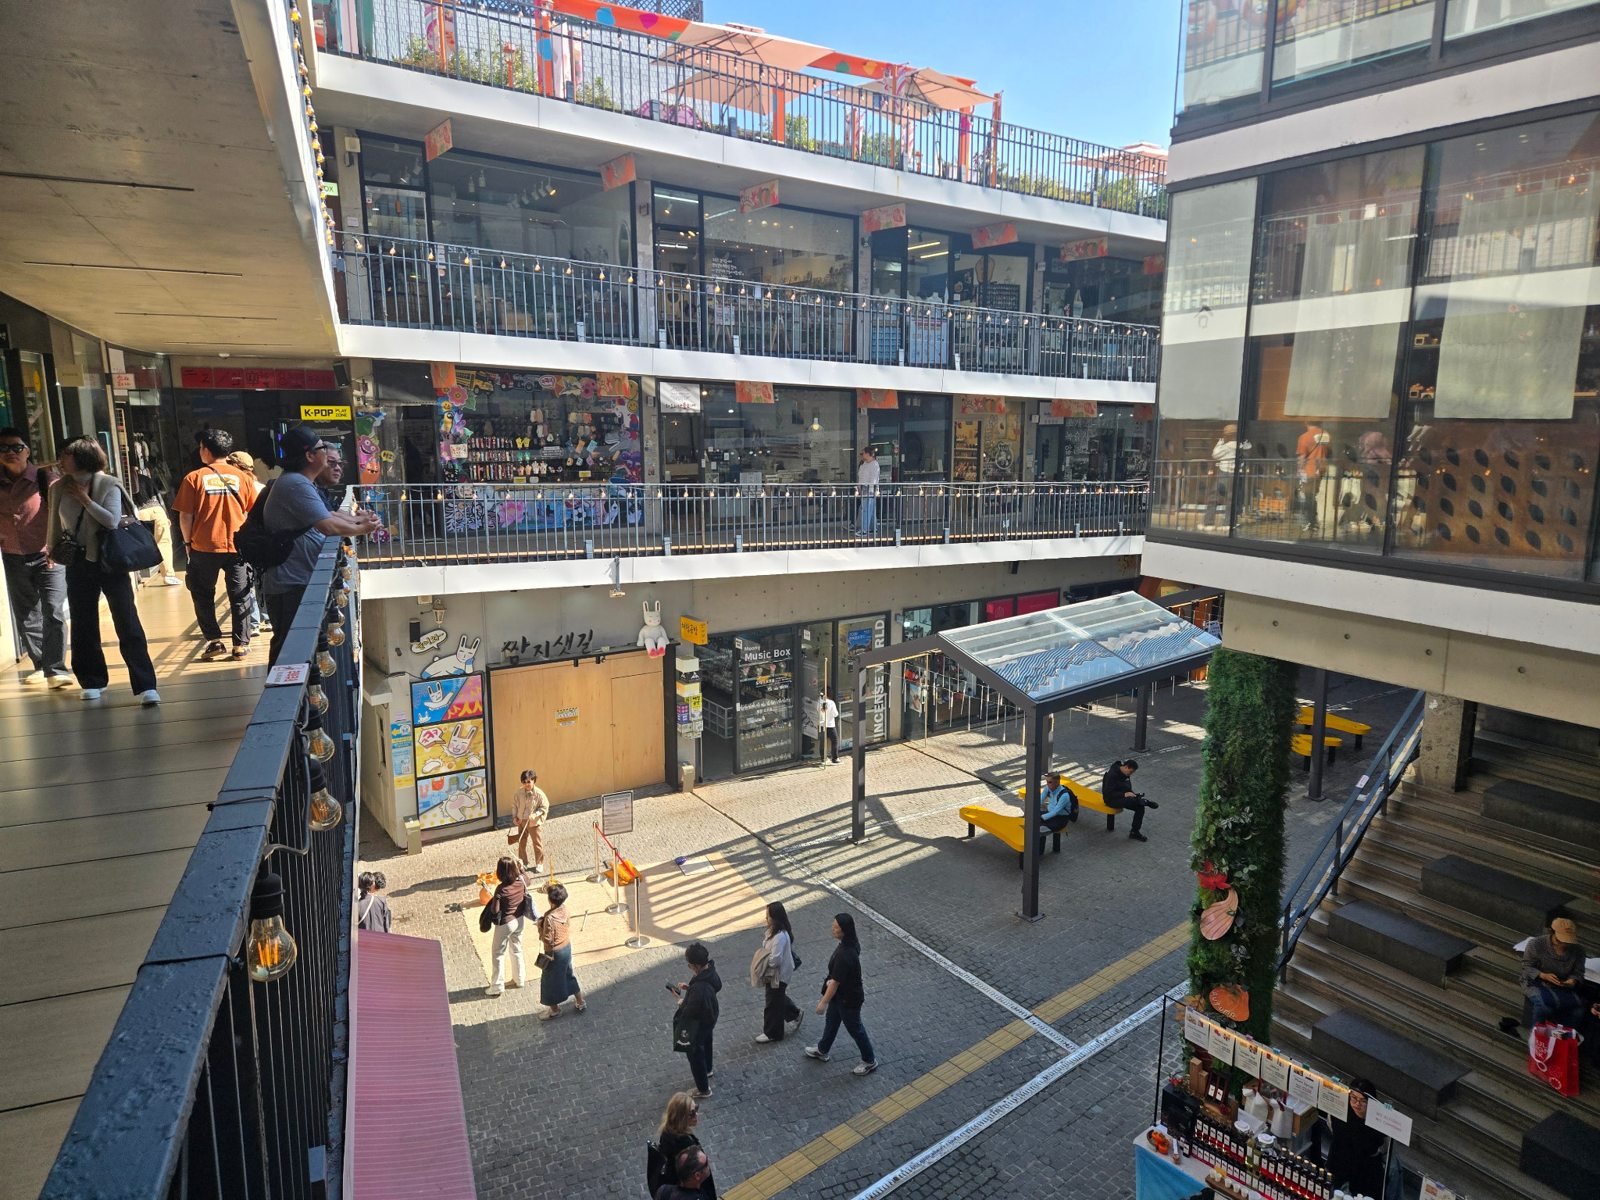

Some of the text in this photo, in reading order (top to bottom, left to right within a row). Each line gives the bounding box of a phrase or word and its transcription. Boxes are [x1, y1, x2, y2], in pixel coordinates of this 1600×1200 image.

[304, 408, 333, 417] K-POP
[744, 648, 791, 662] Music Box
[873, 620, 885, 737] INCENSE WRLD
